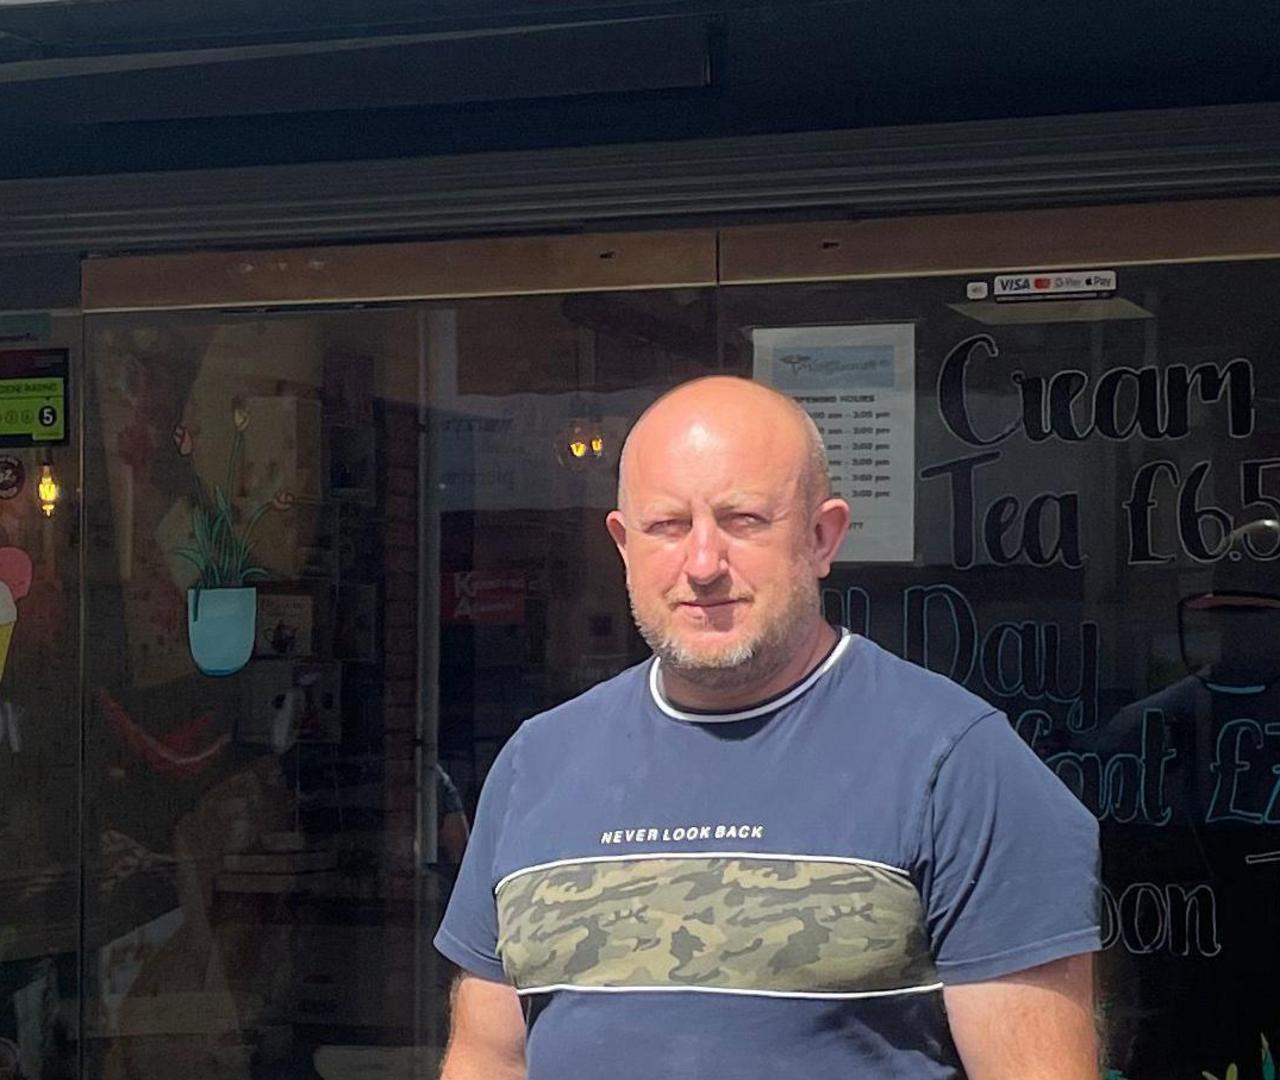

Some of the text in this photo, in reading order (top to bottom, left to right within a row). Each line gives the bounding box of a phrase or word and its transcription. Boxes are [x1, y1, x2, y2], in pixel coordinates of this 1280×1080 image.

[999, 278, 1031, 291] VISA
[42, 408, 53, 424] 5
[937, 335, 1255, 446] Cream
[920, 446, 1089, 568] Tea
[902, 584, 1100, 734] Day
[601, 824, 765, 845] NEVER LOOK BACK
